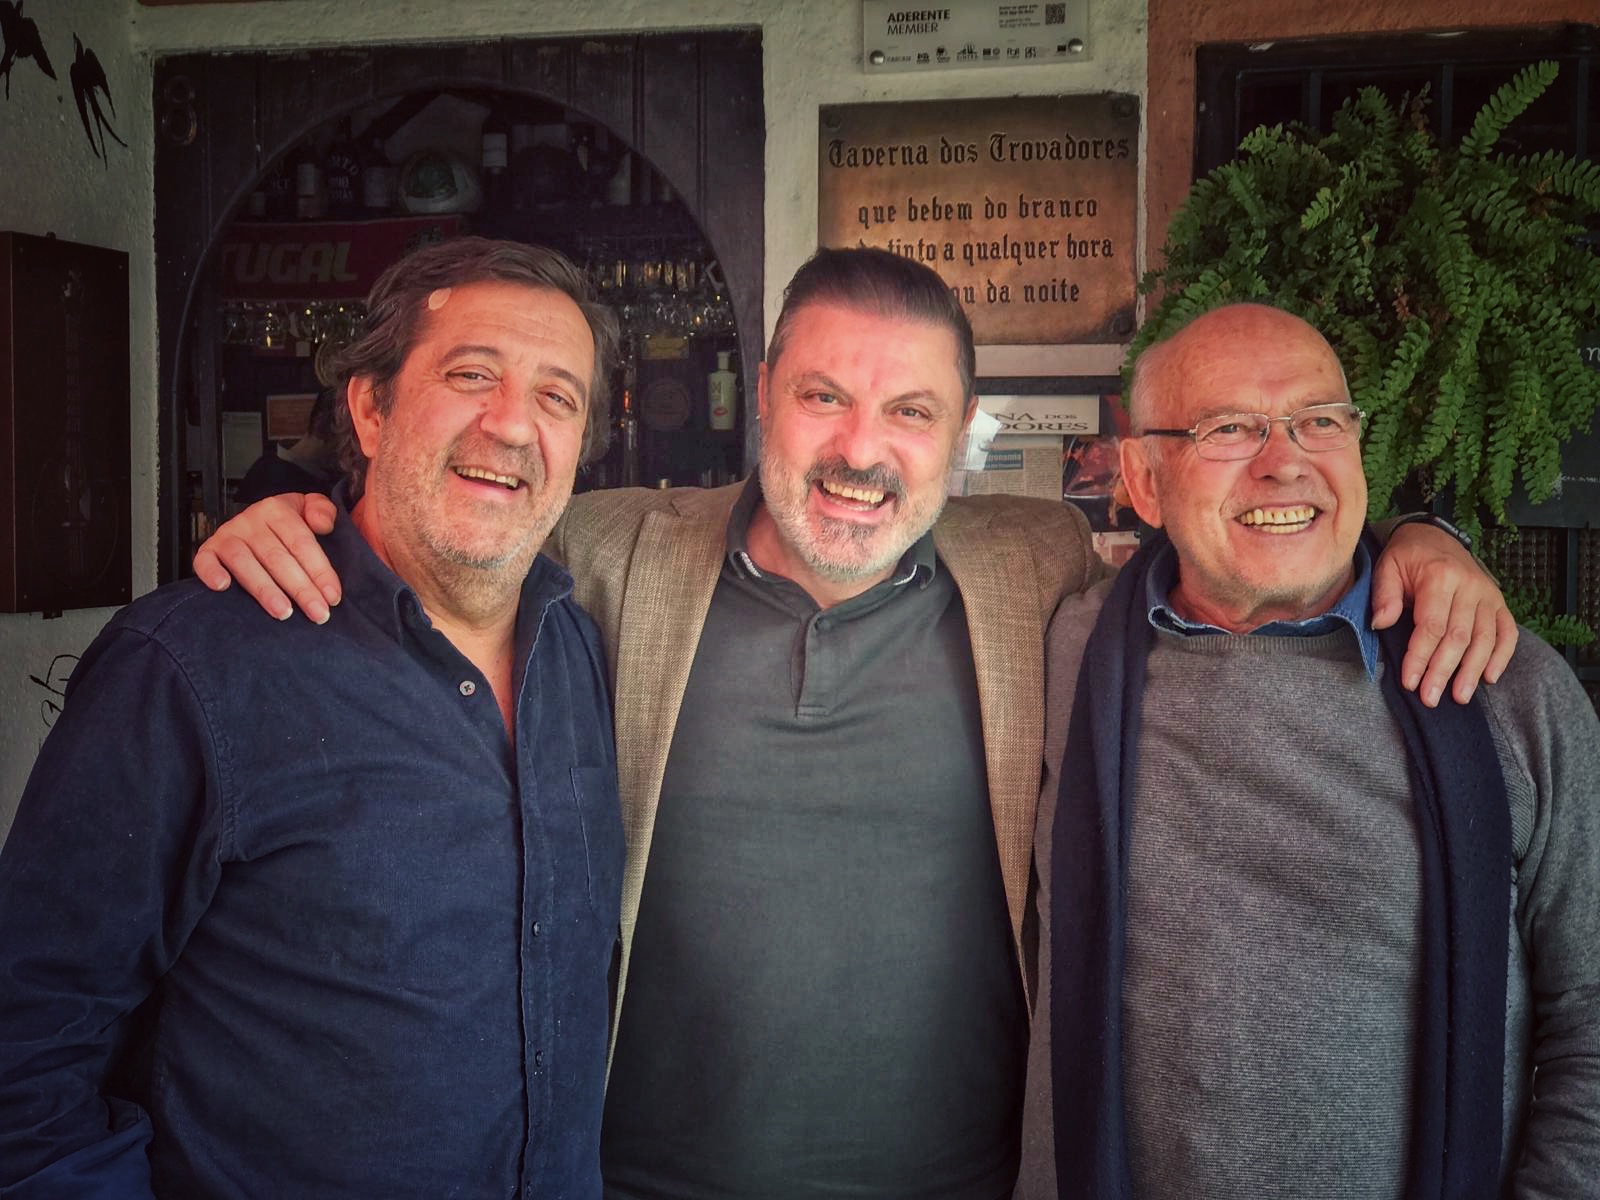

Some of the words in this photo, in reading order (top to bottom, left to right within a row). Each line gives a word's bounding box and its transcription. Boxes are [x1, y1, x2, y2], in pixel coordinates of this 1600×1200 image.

[887, 9, 951, 23] ADERENTE
[887, 22, 939, 36] MEMBER
[828, 138, 929, 168] Taverna
[940, 136, 979, 165] dos
[989, 131, 1130, 163] Trovadores
[858, 203, 897, 229] que
[908, 197, 973, 222] bebem
[984, 196, 1008, 220] do
[1018, 194, 1098, 219] branco
[943, 242, 955, 261] a
[962, 234, 1060, 266] qualquer
[1066, 233, 1114, 260] hora
[987, 278, 1011, 304] da
[1023, 278, 1080, 303] noite
